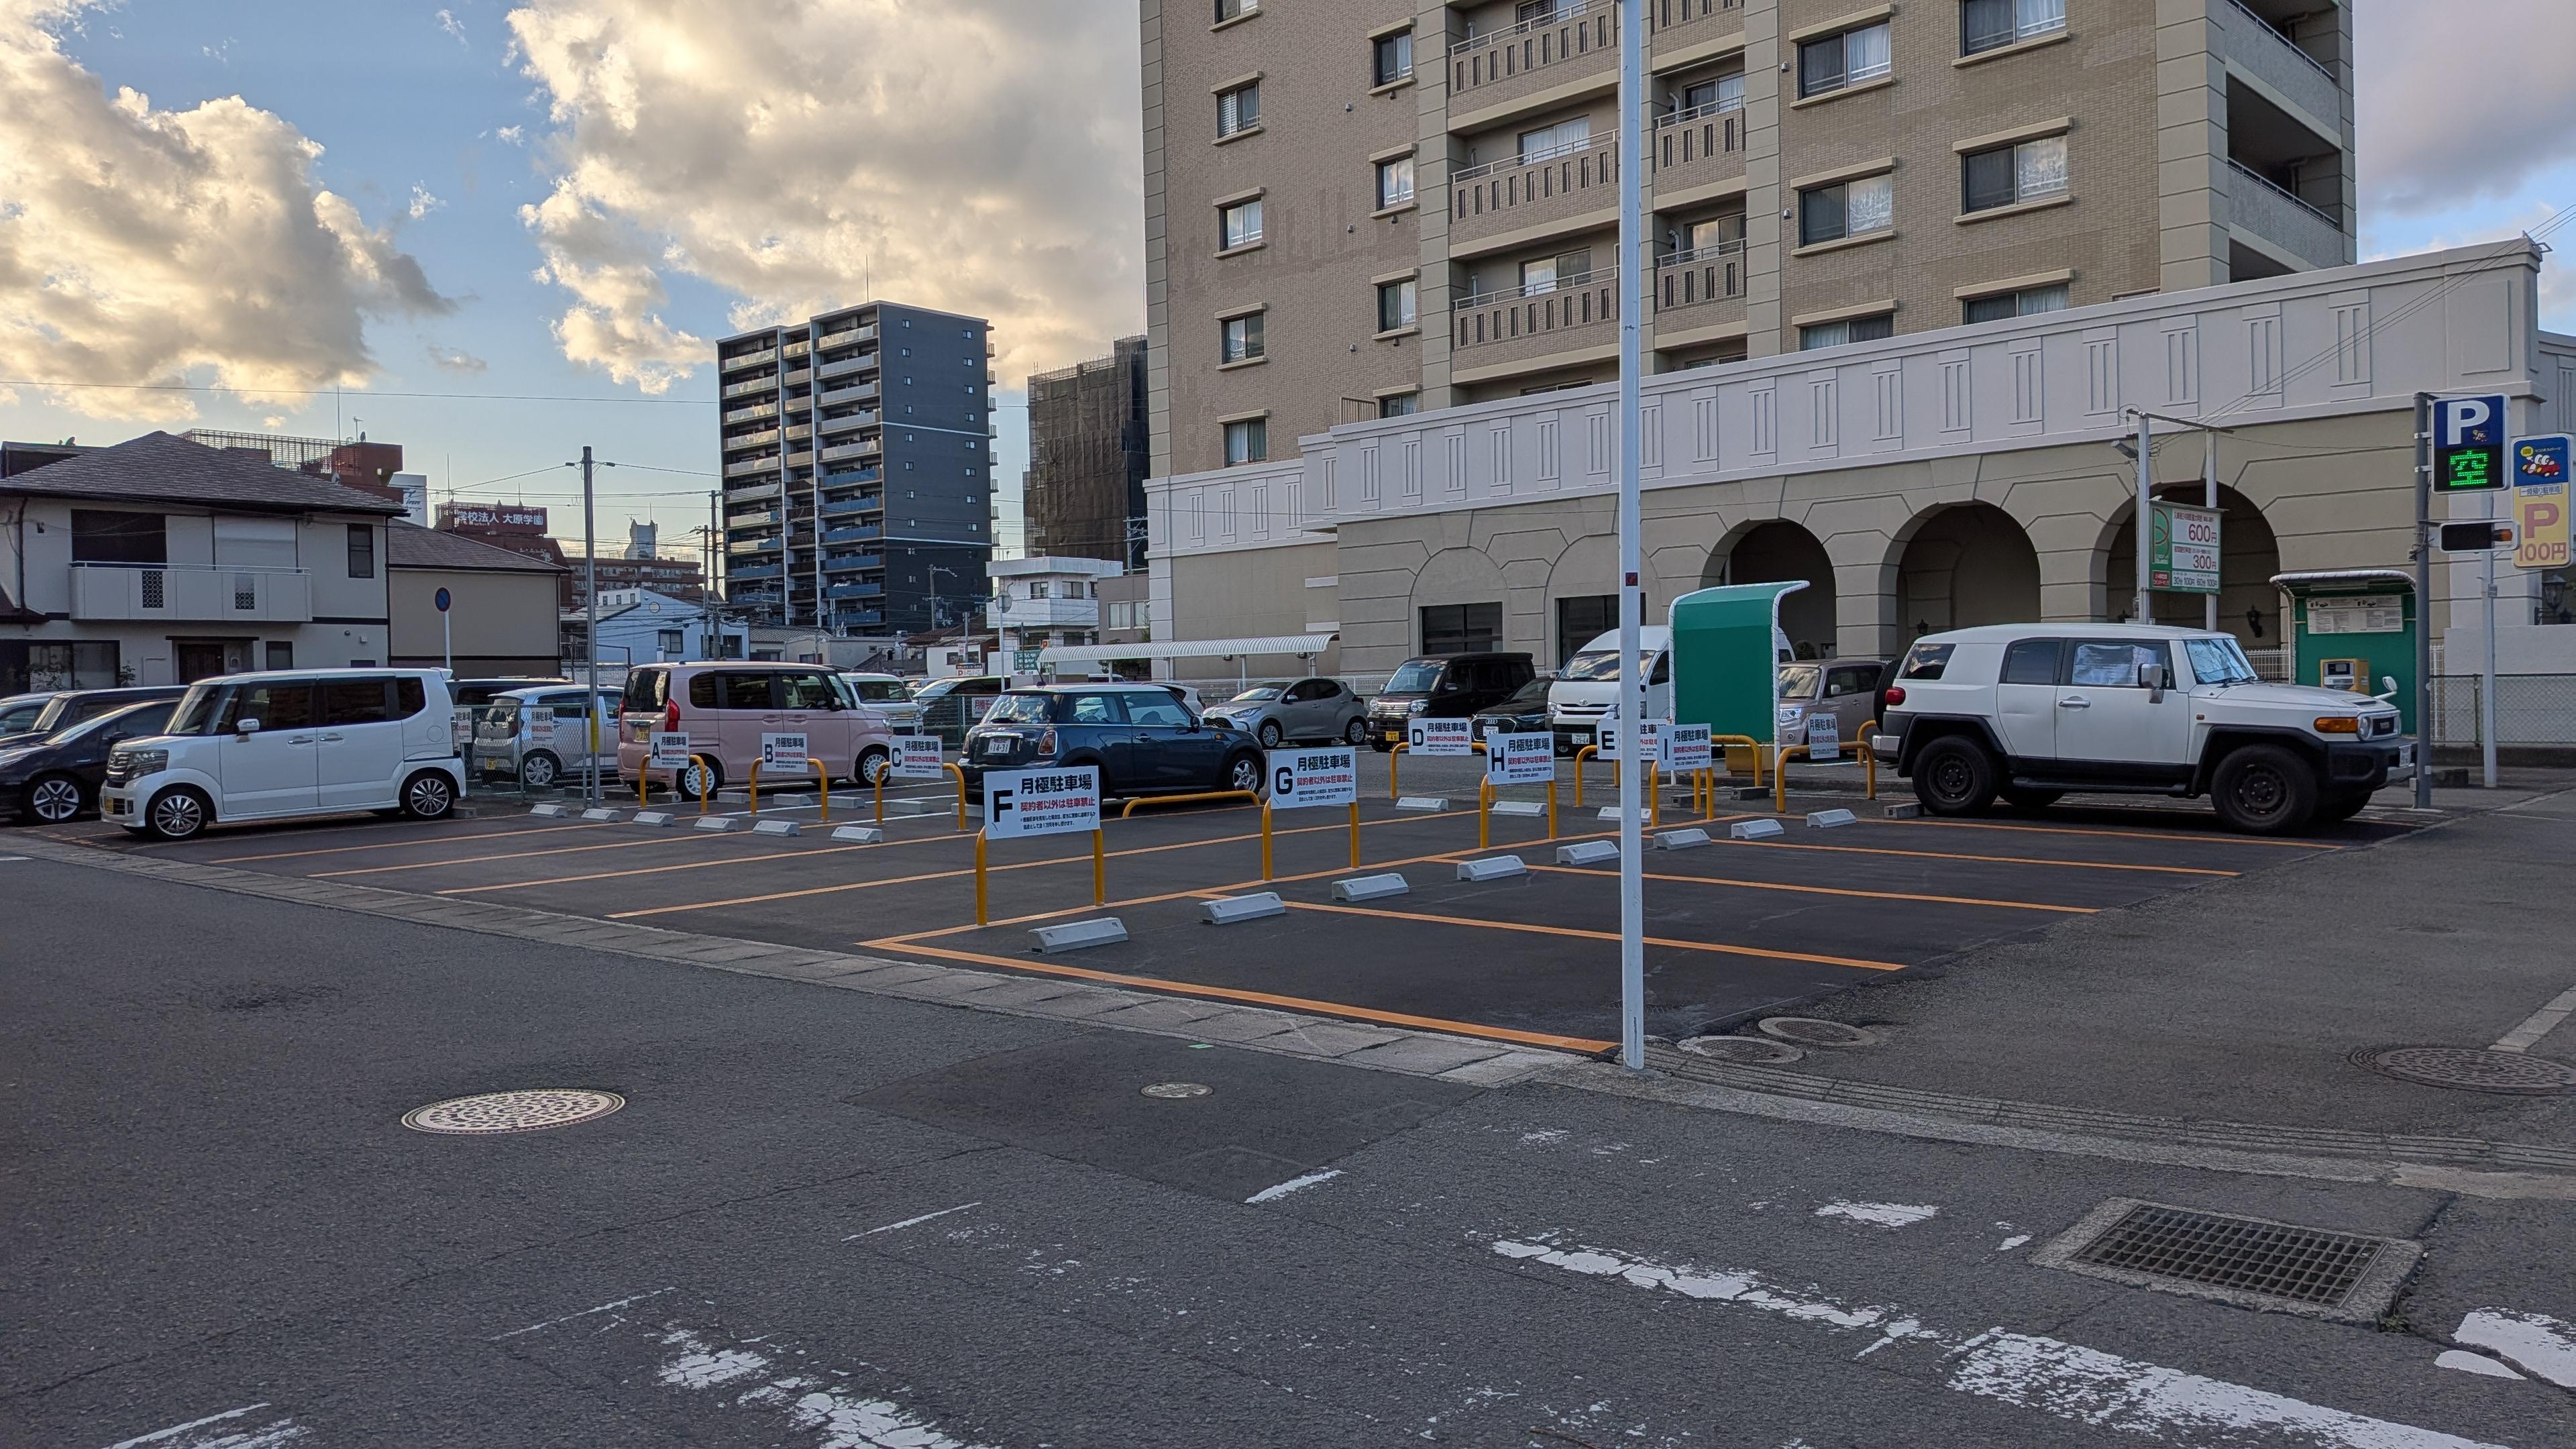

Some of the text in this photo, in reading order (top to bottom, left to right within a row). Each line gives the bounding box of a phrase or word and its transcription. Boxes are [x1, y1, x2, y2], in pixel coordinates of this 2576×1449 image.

[2447, 400, 2489, 445] P
[2450, 450, 2488, 486] 空
[502, 514, 543, 525] 大原学園
[2524, 502, 2559, 539] P
[2188, 523, 2217, 543] 600円
[2519, 542, 2567, 561] 100円
[2193, 555, 2216, 570] 300円
[1428, 722, 1467, 732] 月極駐車場
[1674, 729, 1708, 742] 月極駐車場
[905, 741, 938, 751] 月極駐車場
[1412, 729, 1424, 746] D
[1508, 738, 1550, 752] 月極駐車場
[1601, 731, 1615, 750] E
[652, 742, 660, 759] A
[765, 744, 773, 763] B
[892, 747, 902, 767] C
[1491, 747, 1505, 771] H
[1297, 754, 1350, 771] 月極駐車場
[1020, 773, 1092, 795] 月極駐車場
[1275, 766, 1293, 795] G
[1297, 774, 1353, 786] 契約者以外は駐車禁止
[993, 790, 1014, 822] F
[1020, 796, 1095, 812] 契約者以外は駐車禁止
